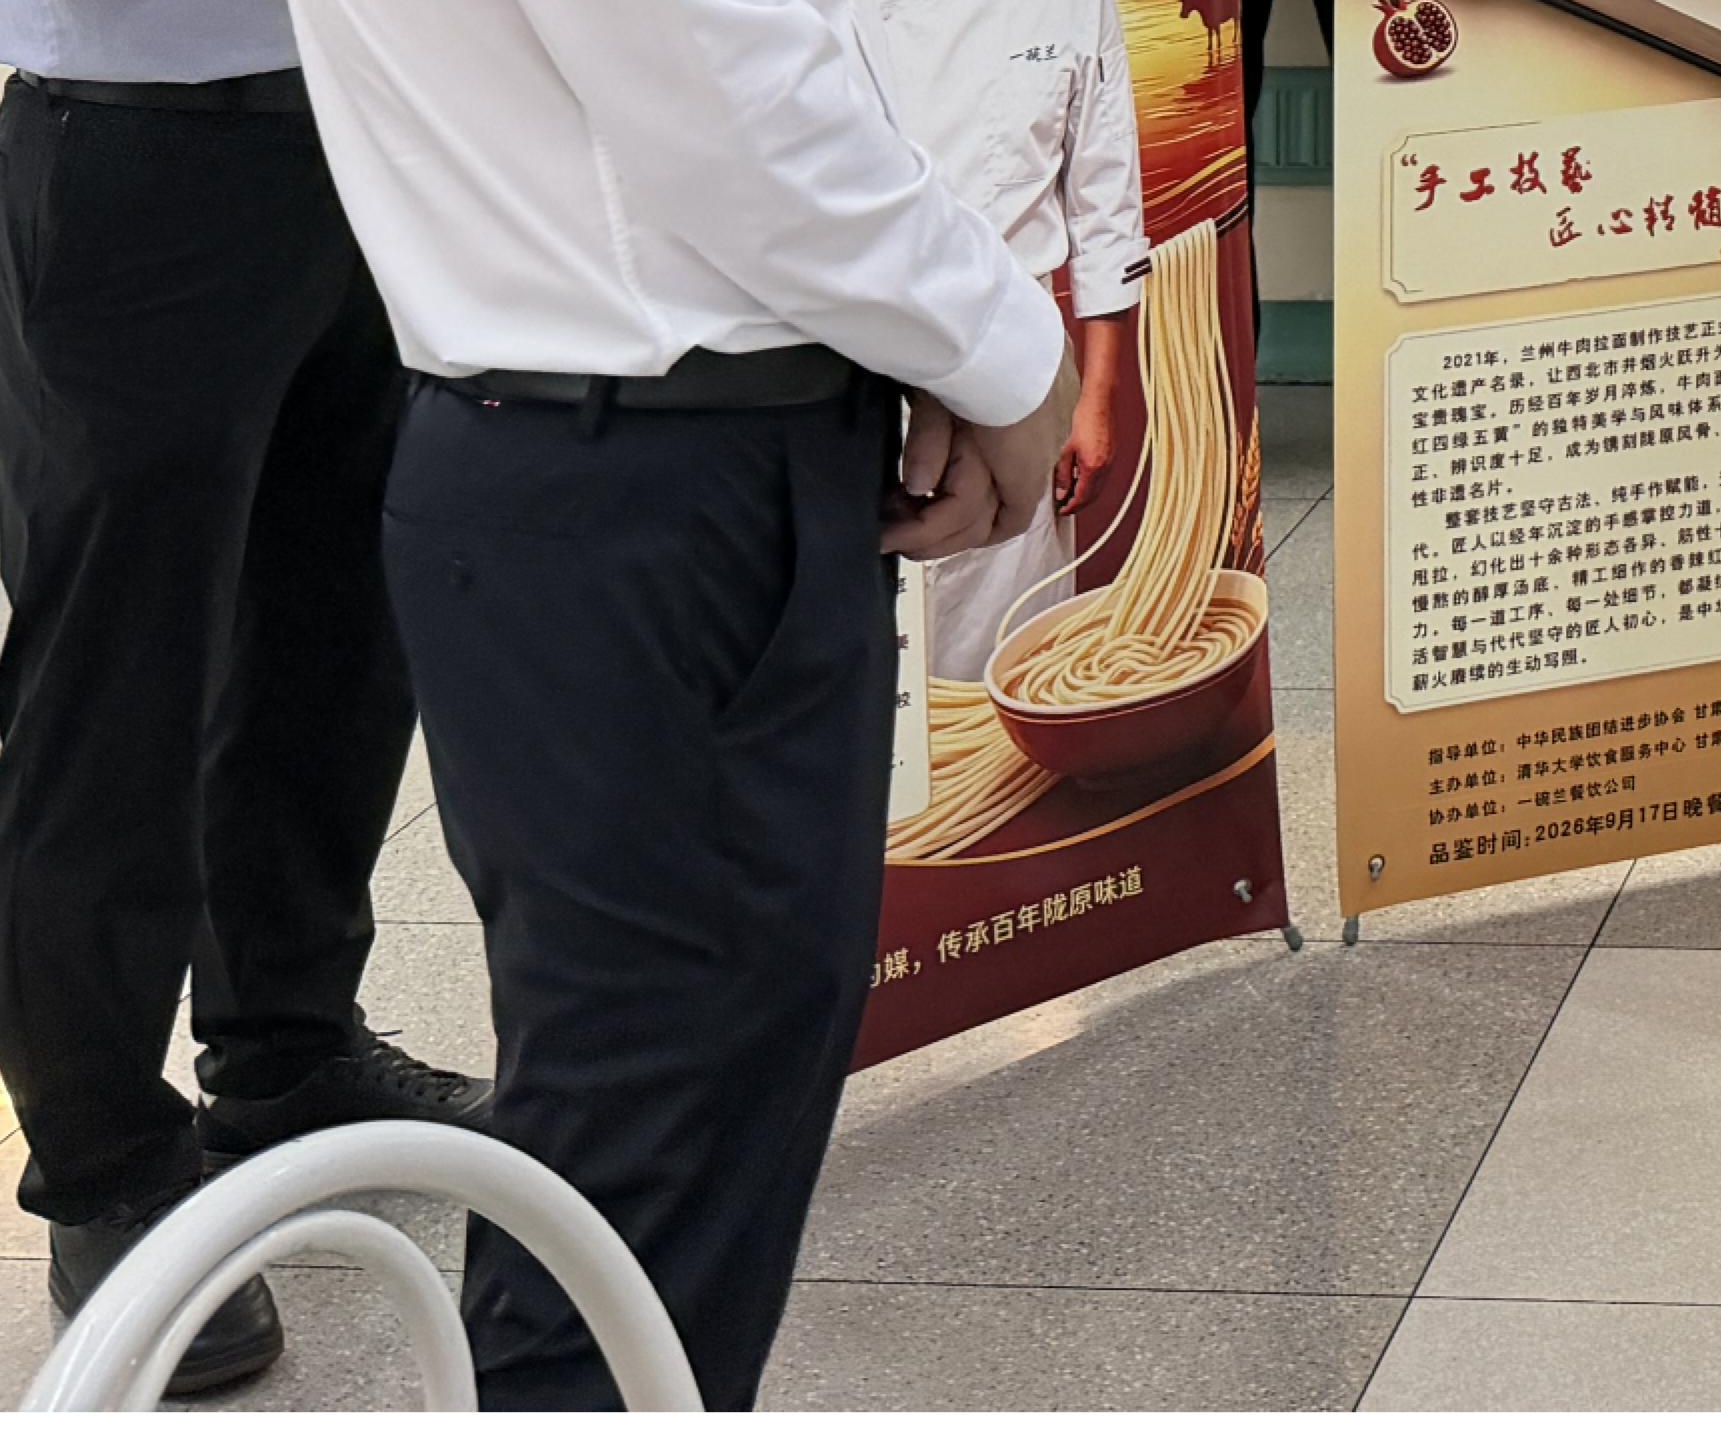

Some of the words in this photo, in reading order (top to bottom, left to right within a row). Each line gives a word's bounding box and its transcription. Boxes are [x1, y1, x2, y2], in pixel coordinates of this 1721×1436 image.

[870, 865, 1145, 989] 媒，传承百年陇原味道
